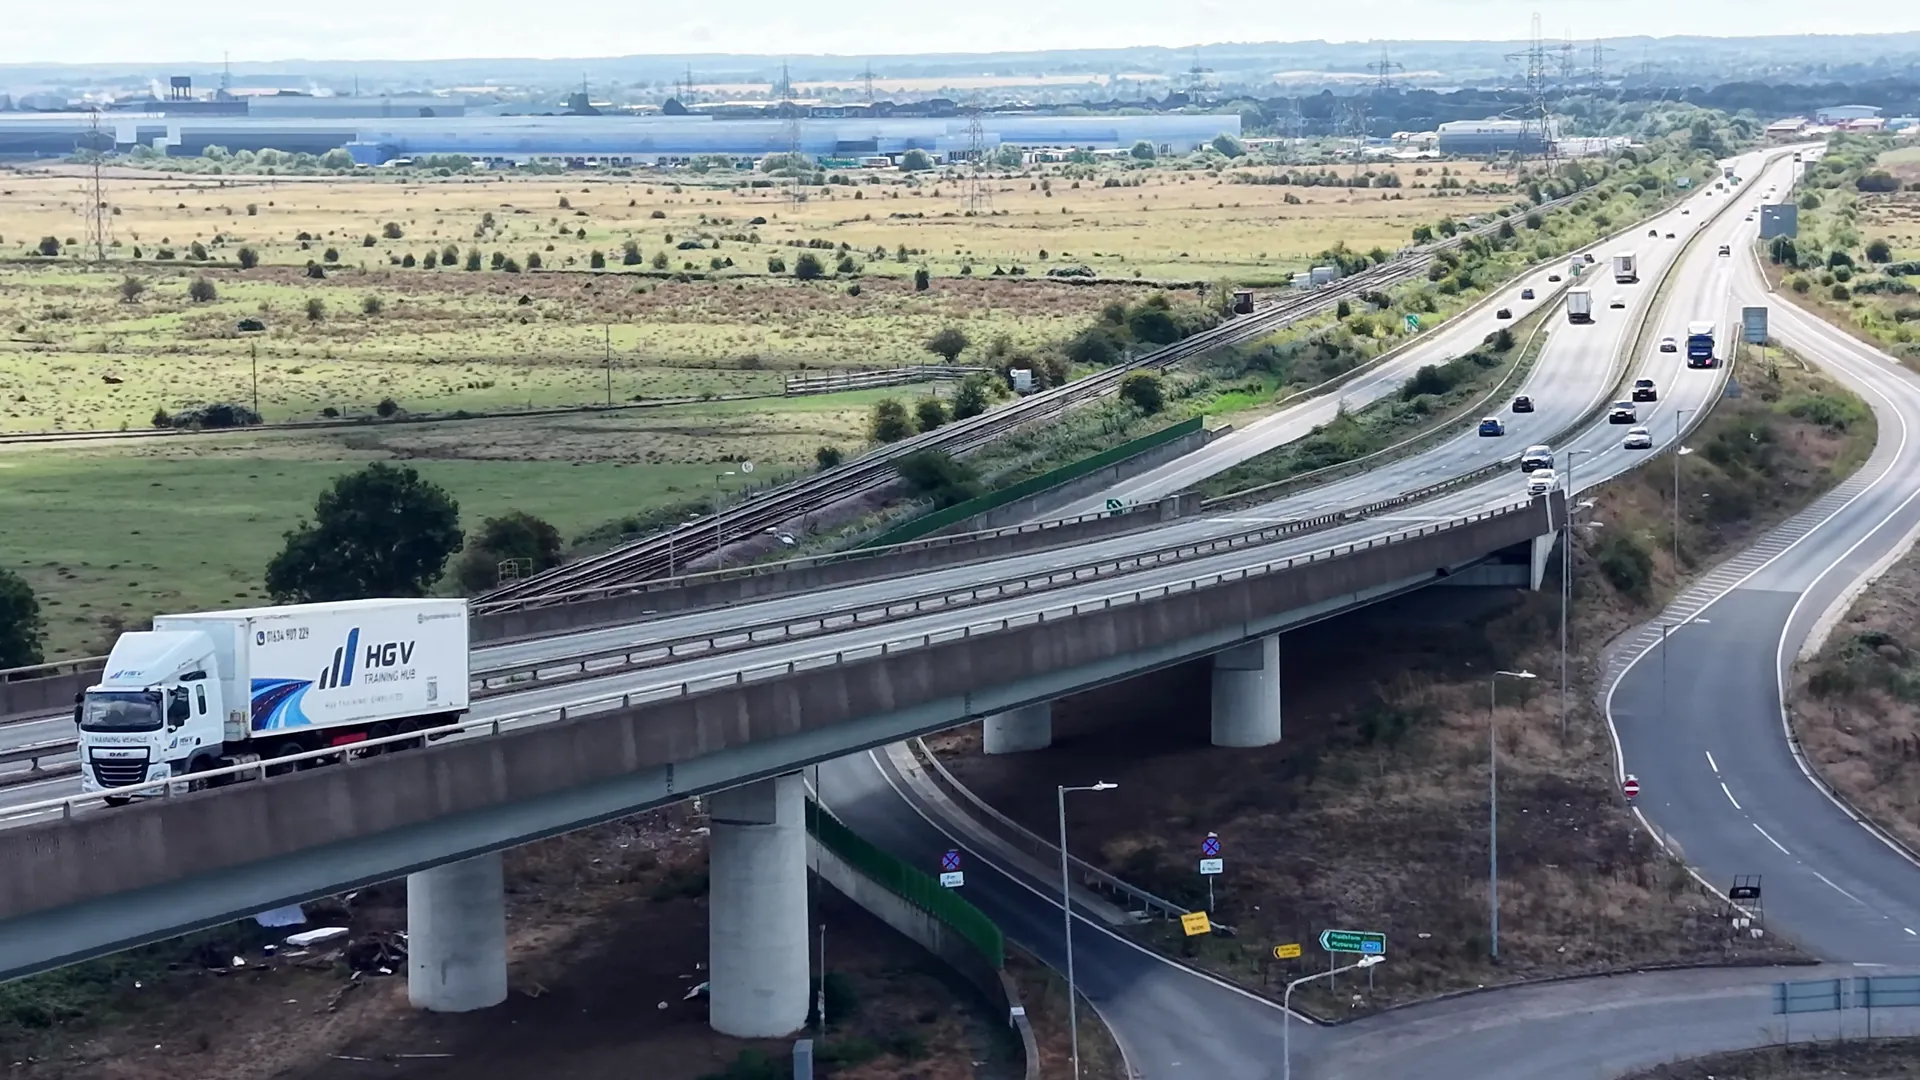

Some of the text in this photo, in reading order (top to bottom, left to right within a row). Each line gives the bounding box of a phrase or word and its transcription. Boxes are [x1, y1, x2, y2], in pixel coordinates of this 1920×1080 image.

[365, 640, 416, 669] HGV
[364, 668, 416, 685] TRAINING HUB
